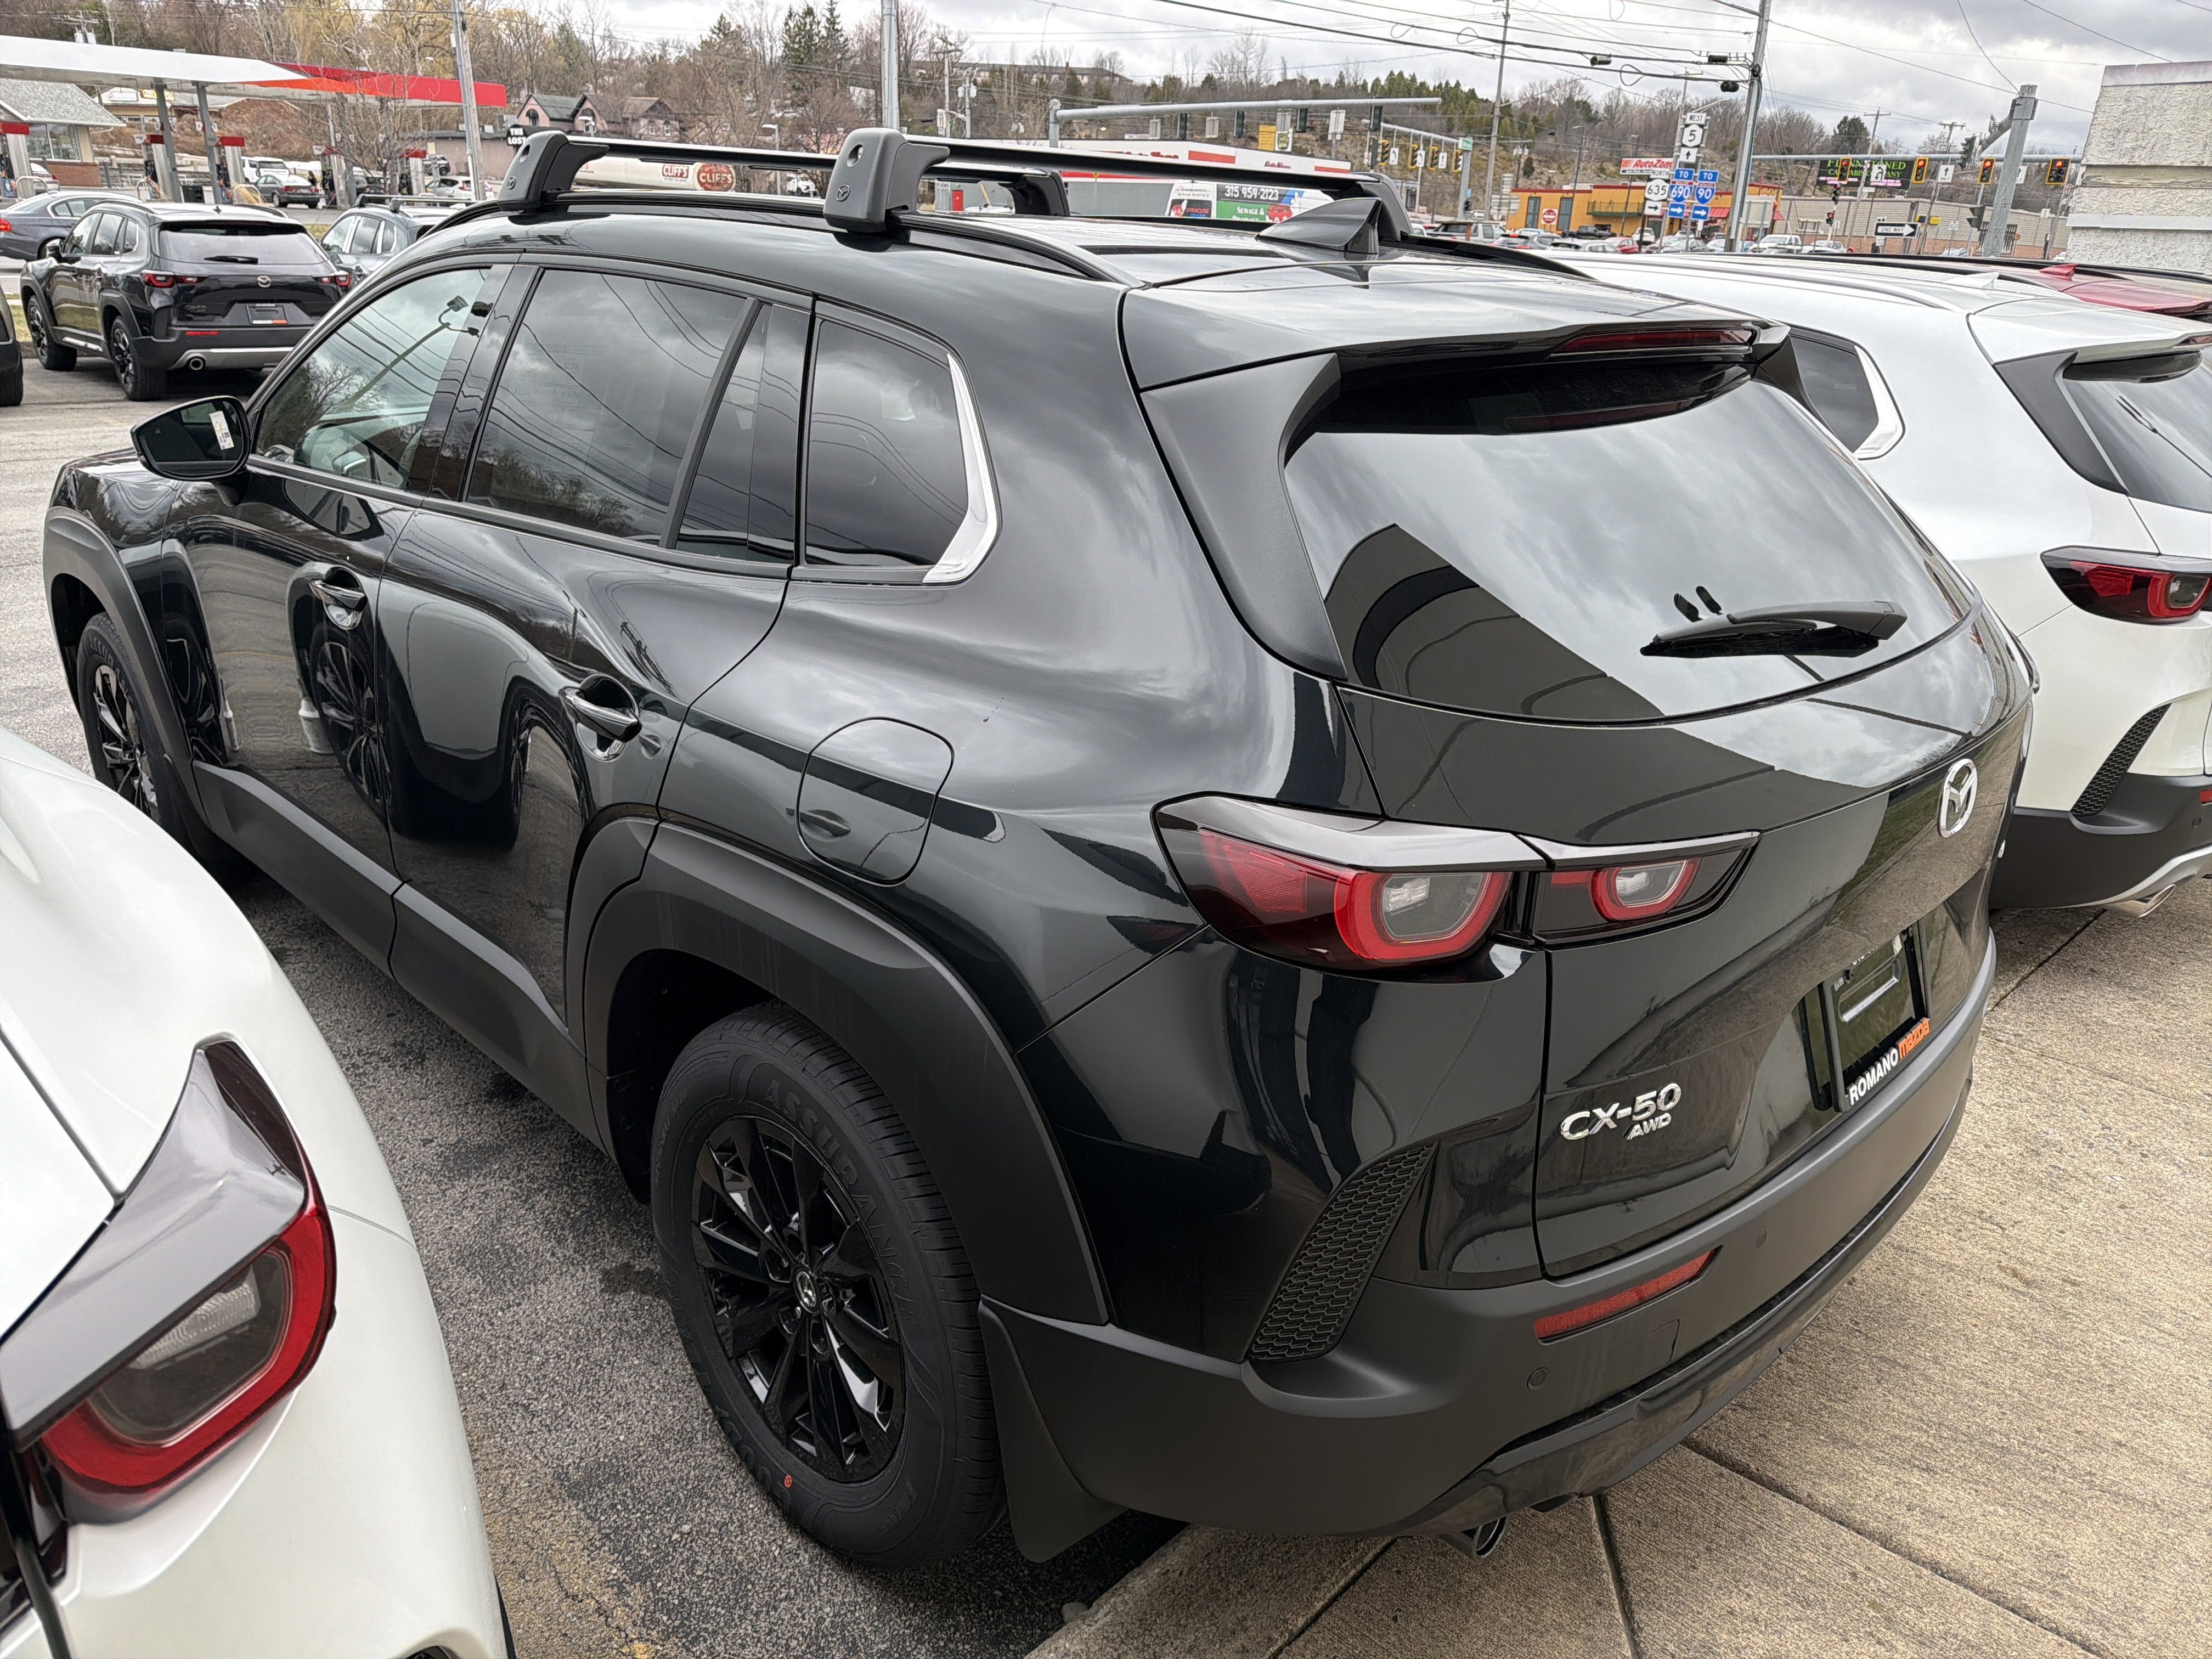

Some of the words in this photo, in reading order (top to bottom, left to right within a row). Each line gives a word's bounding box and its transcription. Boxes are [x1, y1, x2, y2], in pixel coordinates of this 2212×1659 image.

[507, 137, 526, 145] LOST
[1688, 129, 1696, 142] 5
[1224, 185, 1239, 198] 315
[1647, 184, 1667, 195] 635
[1671, 185, 1690, 199] 690
[1697, 188, 1712, 200] 90
[1847, 1046, 1899, 1107] ROMANO
[1560, 1082, 1681, 1141] CX-50
[1625, 1113, 1672, 1141] AWD
